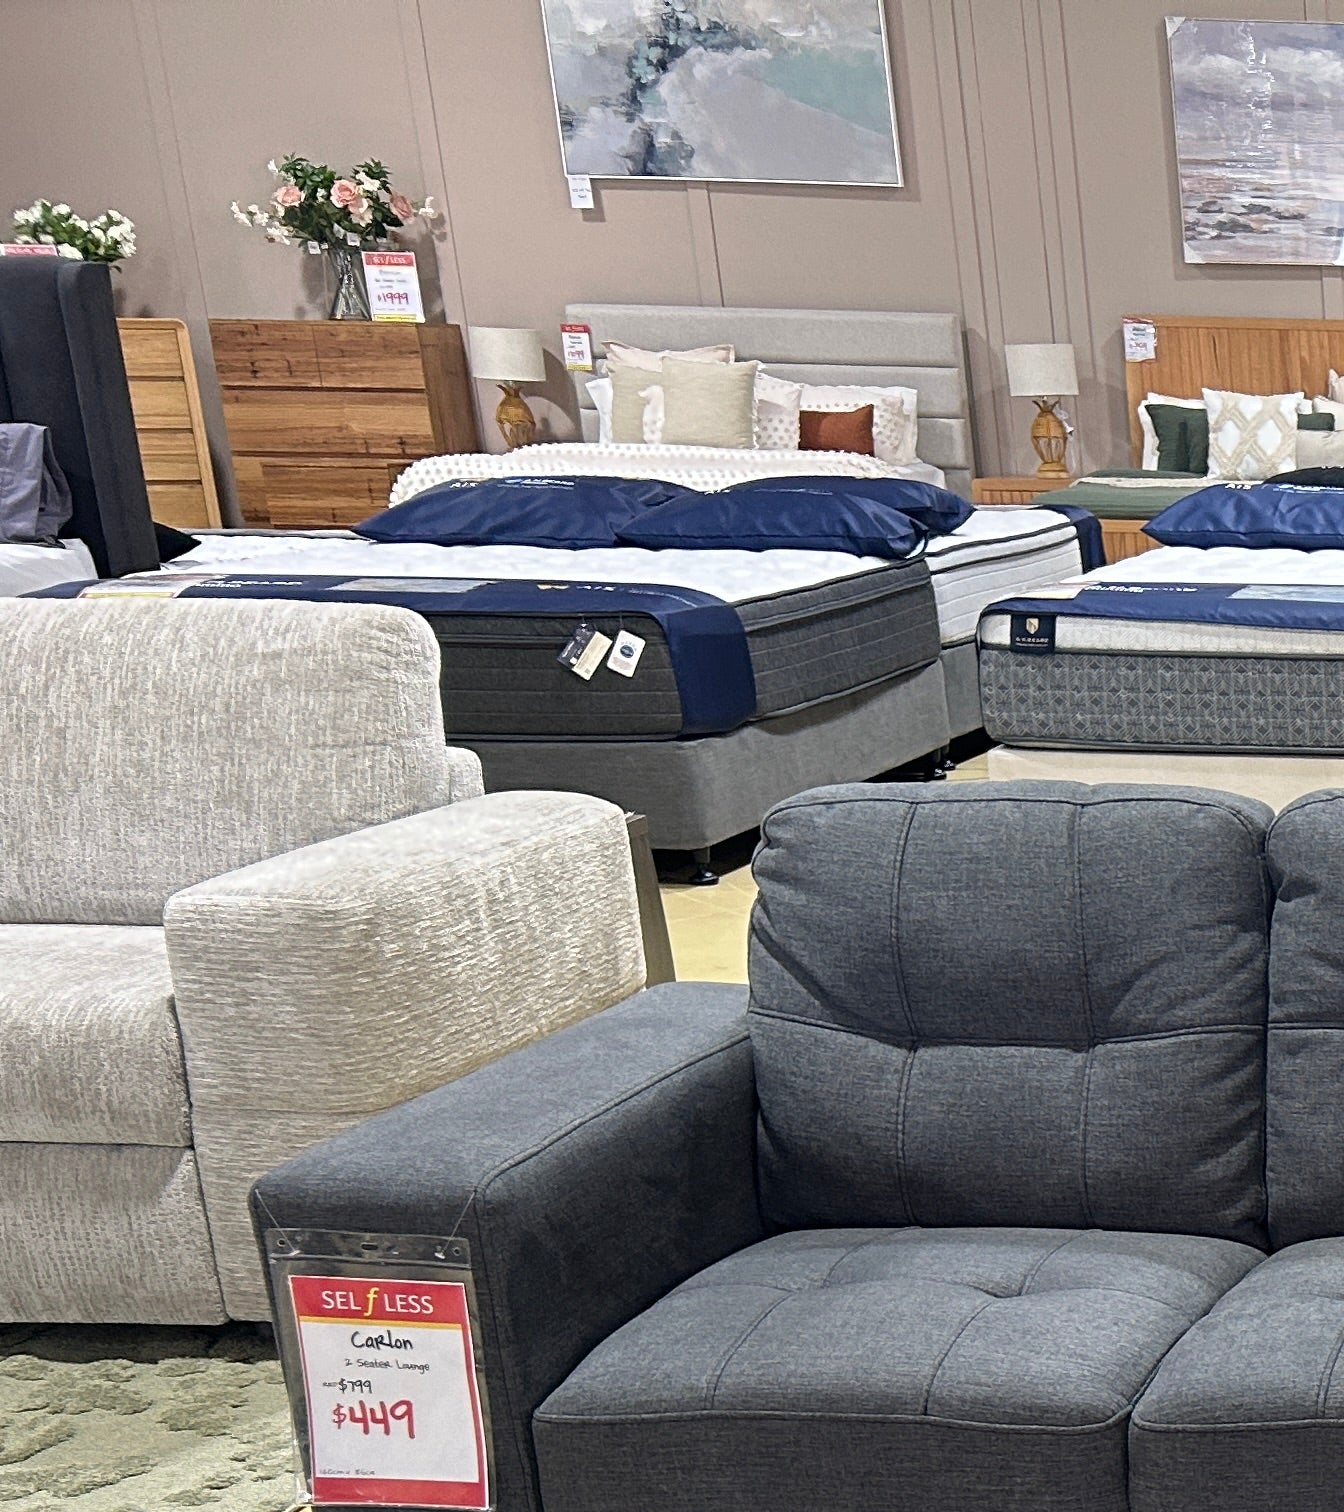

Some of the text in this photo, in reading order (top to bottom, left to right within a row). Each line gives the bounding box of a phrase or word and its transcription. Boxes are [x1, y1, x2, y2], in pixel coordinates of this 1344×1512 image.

[344, 1358, 352, 1366] 2
[396, 1360, 430, 1374] Lounge
[338, 1378, 372, 1394] $799
[332, 1400, 415, 1439] $449
